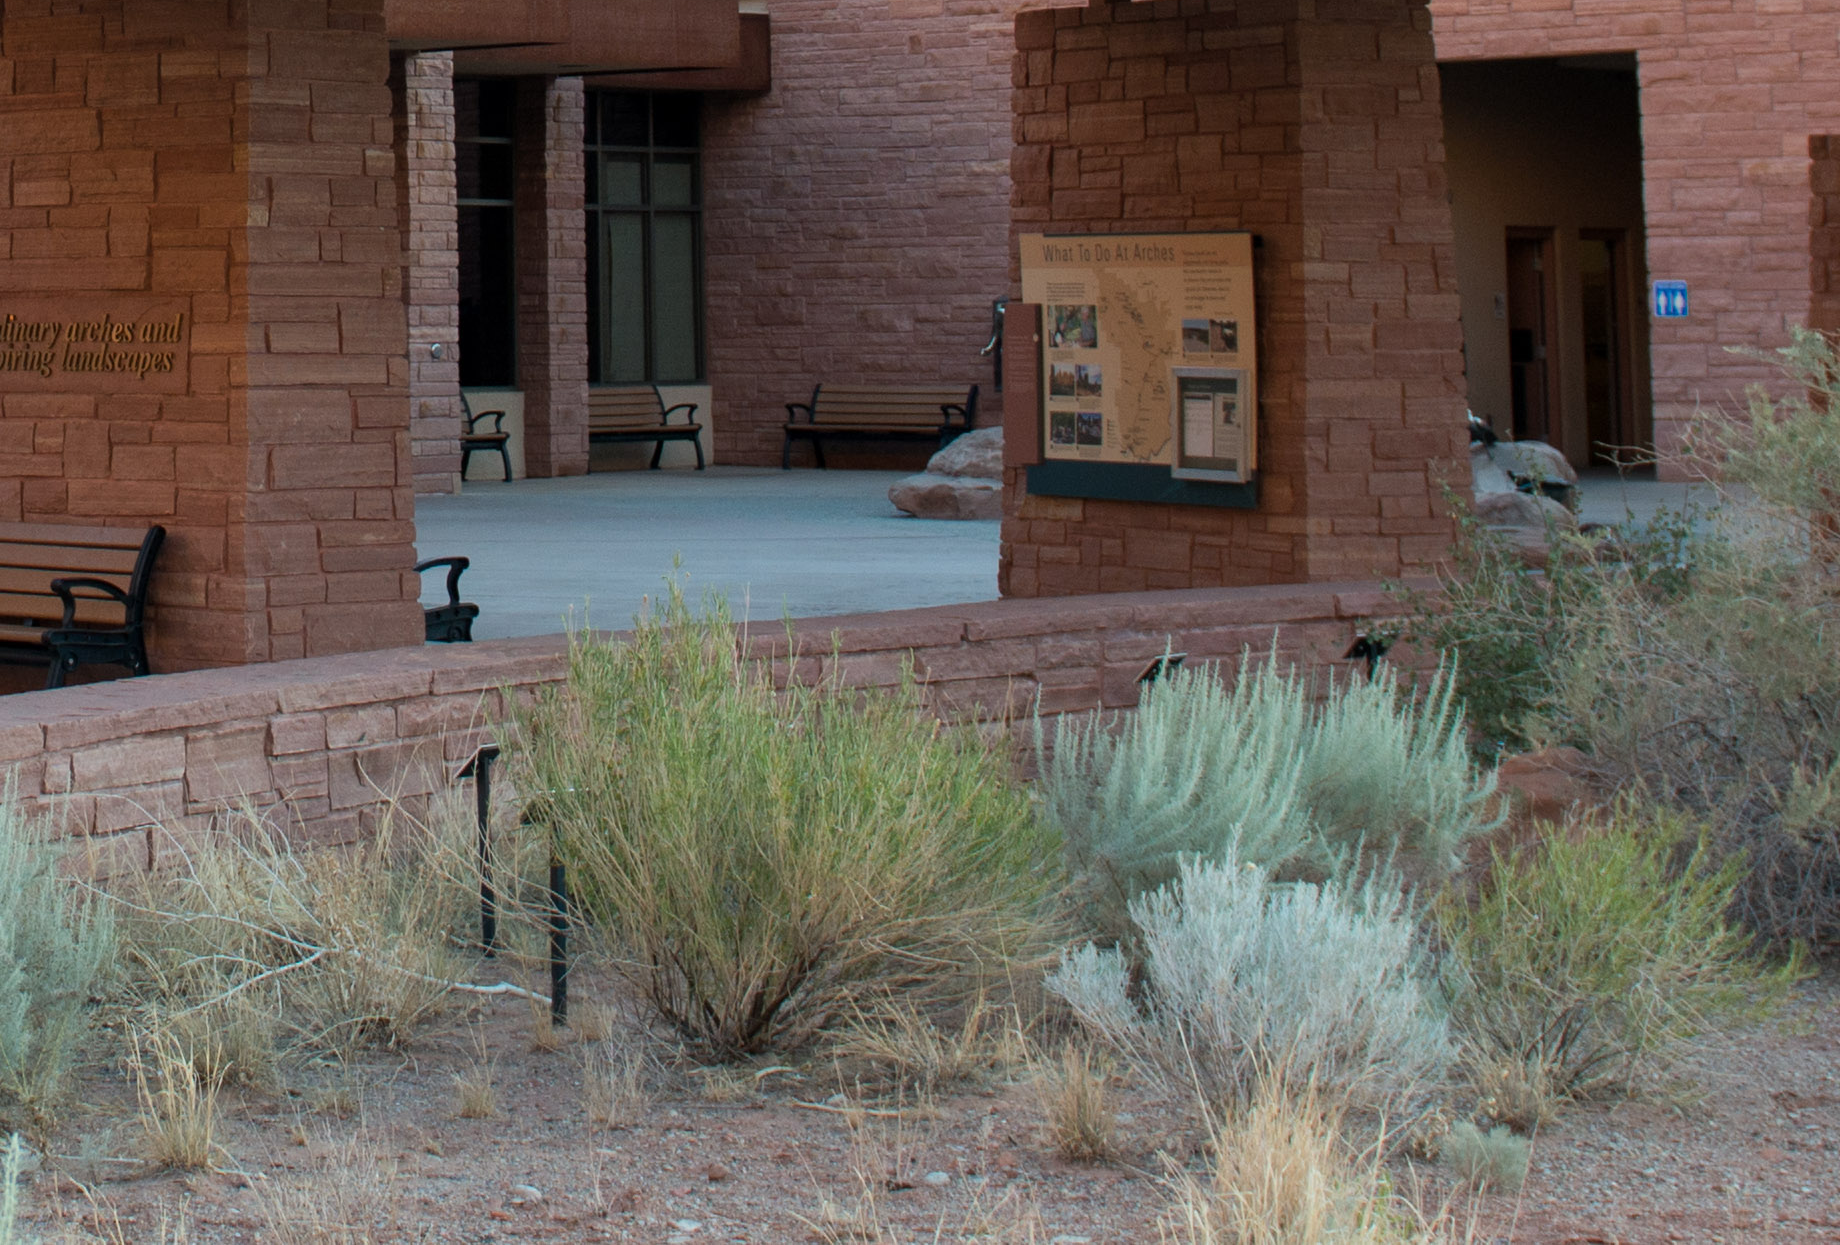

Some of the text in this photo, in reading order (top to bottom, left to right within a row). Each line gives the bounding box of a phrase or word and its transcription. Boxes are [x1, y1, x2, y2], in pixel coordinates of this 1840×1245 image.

[1042, 242, 1176, 262] What To Do At Arches
[65, 313, 136, 343] arches
[139, 313, 184, 343] and
[61, 344, 174, 379] landscapes
